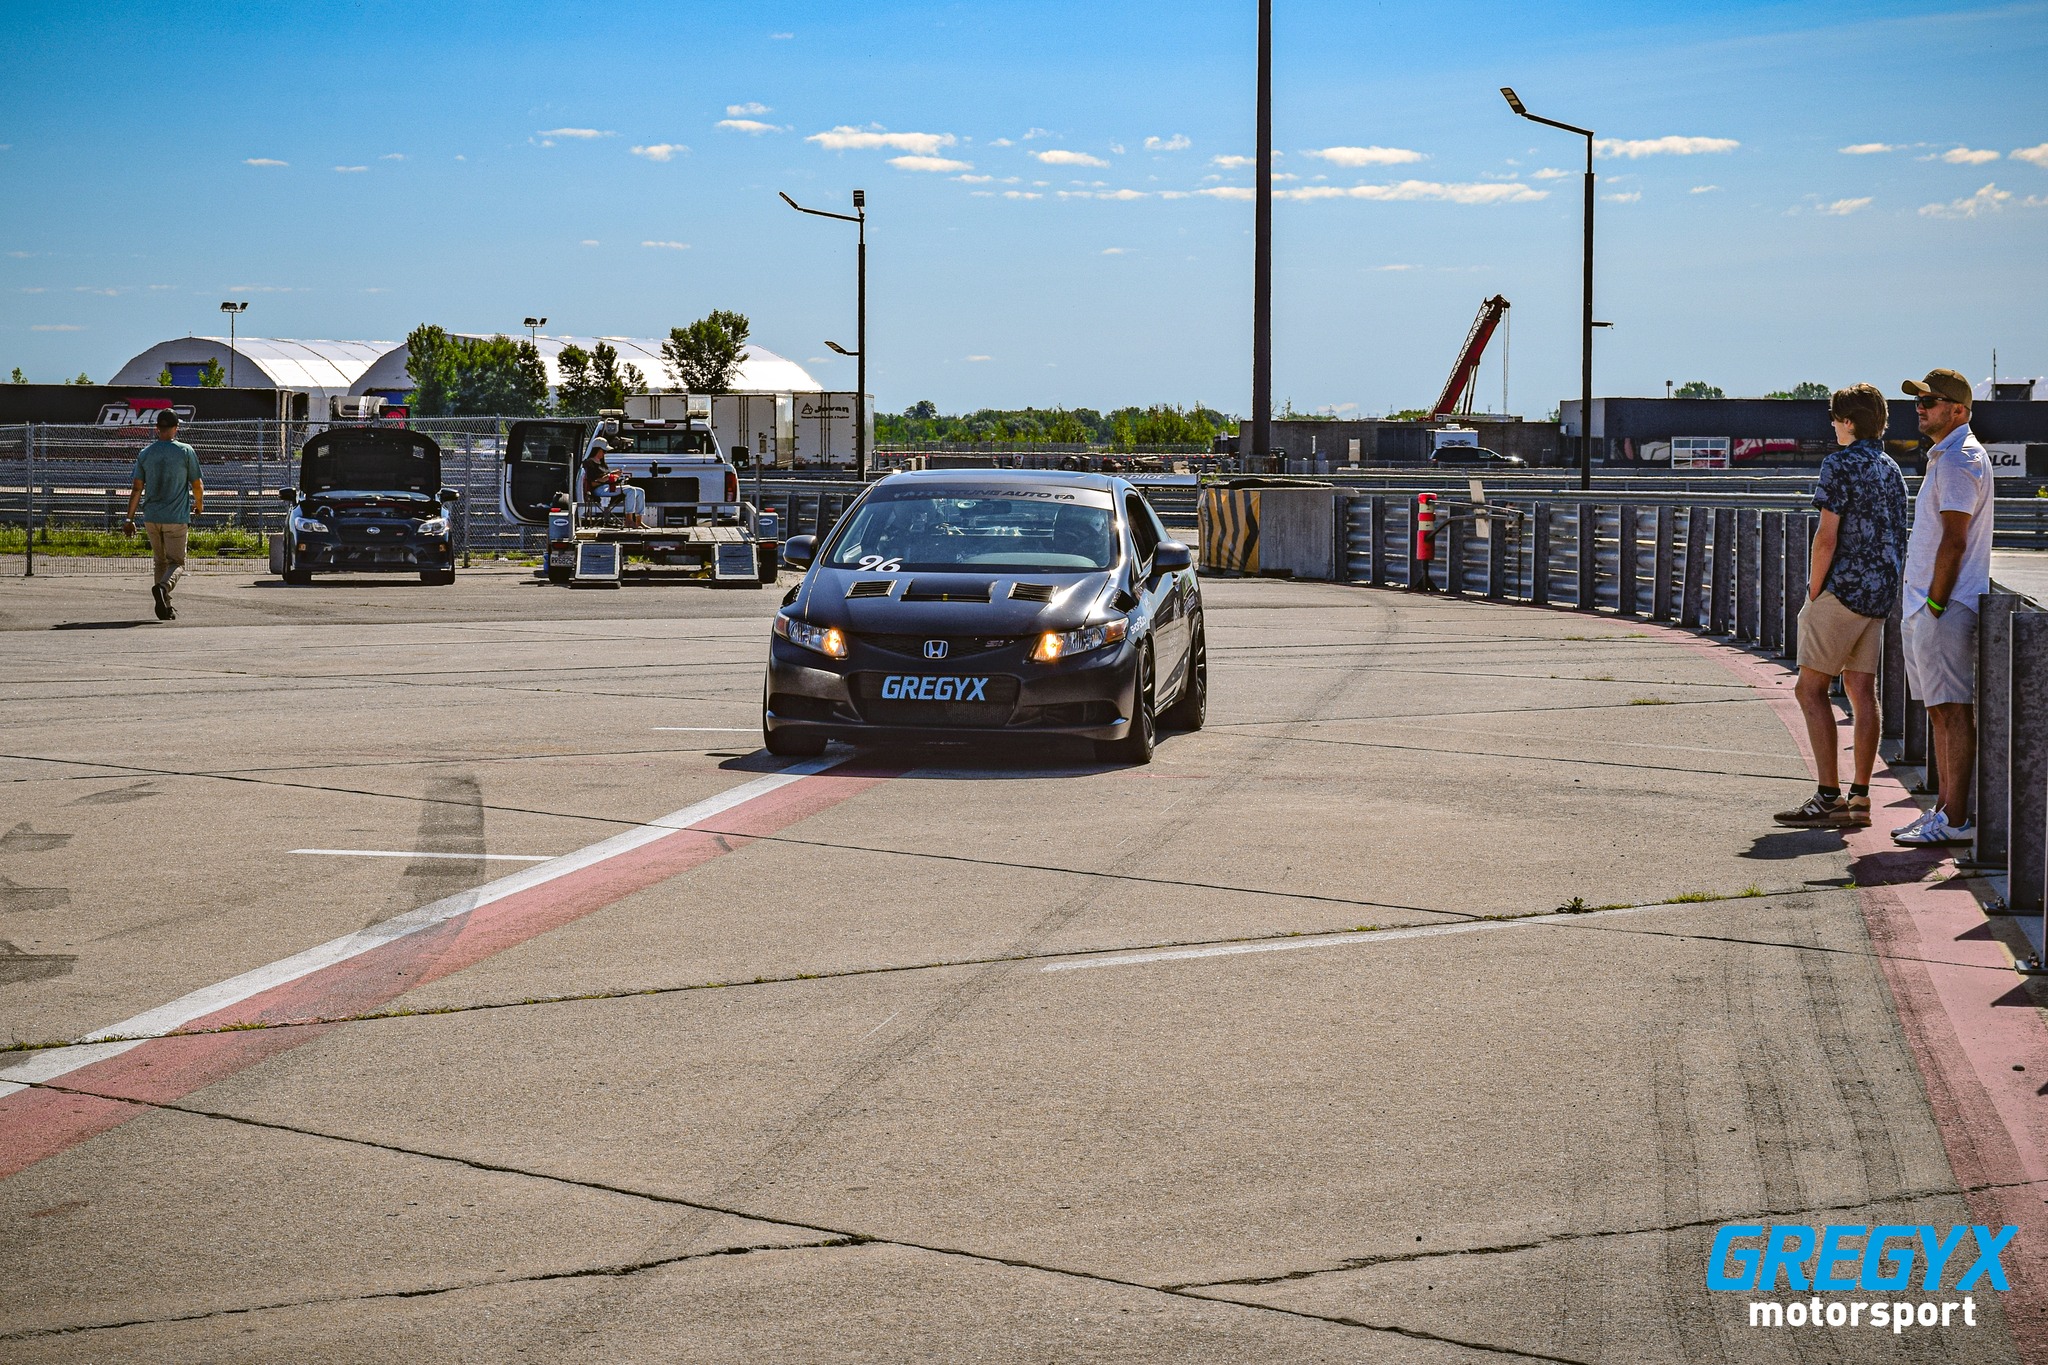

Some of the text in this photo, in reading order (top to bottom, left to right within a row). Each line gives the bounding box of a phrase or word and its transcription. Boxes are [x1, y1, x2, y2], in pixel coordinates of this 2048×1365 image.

[1003, 490, 1052, 499] AUTO
[856, 554, 903, 573] 96
[882, 675, 989, 701] GREGYX
